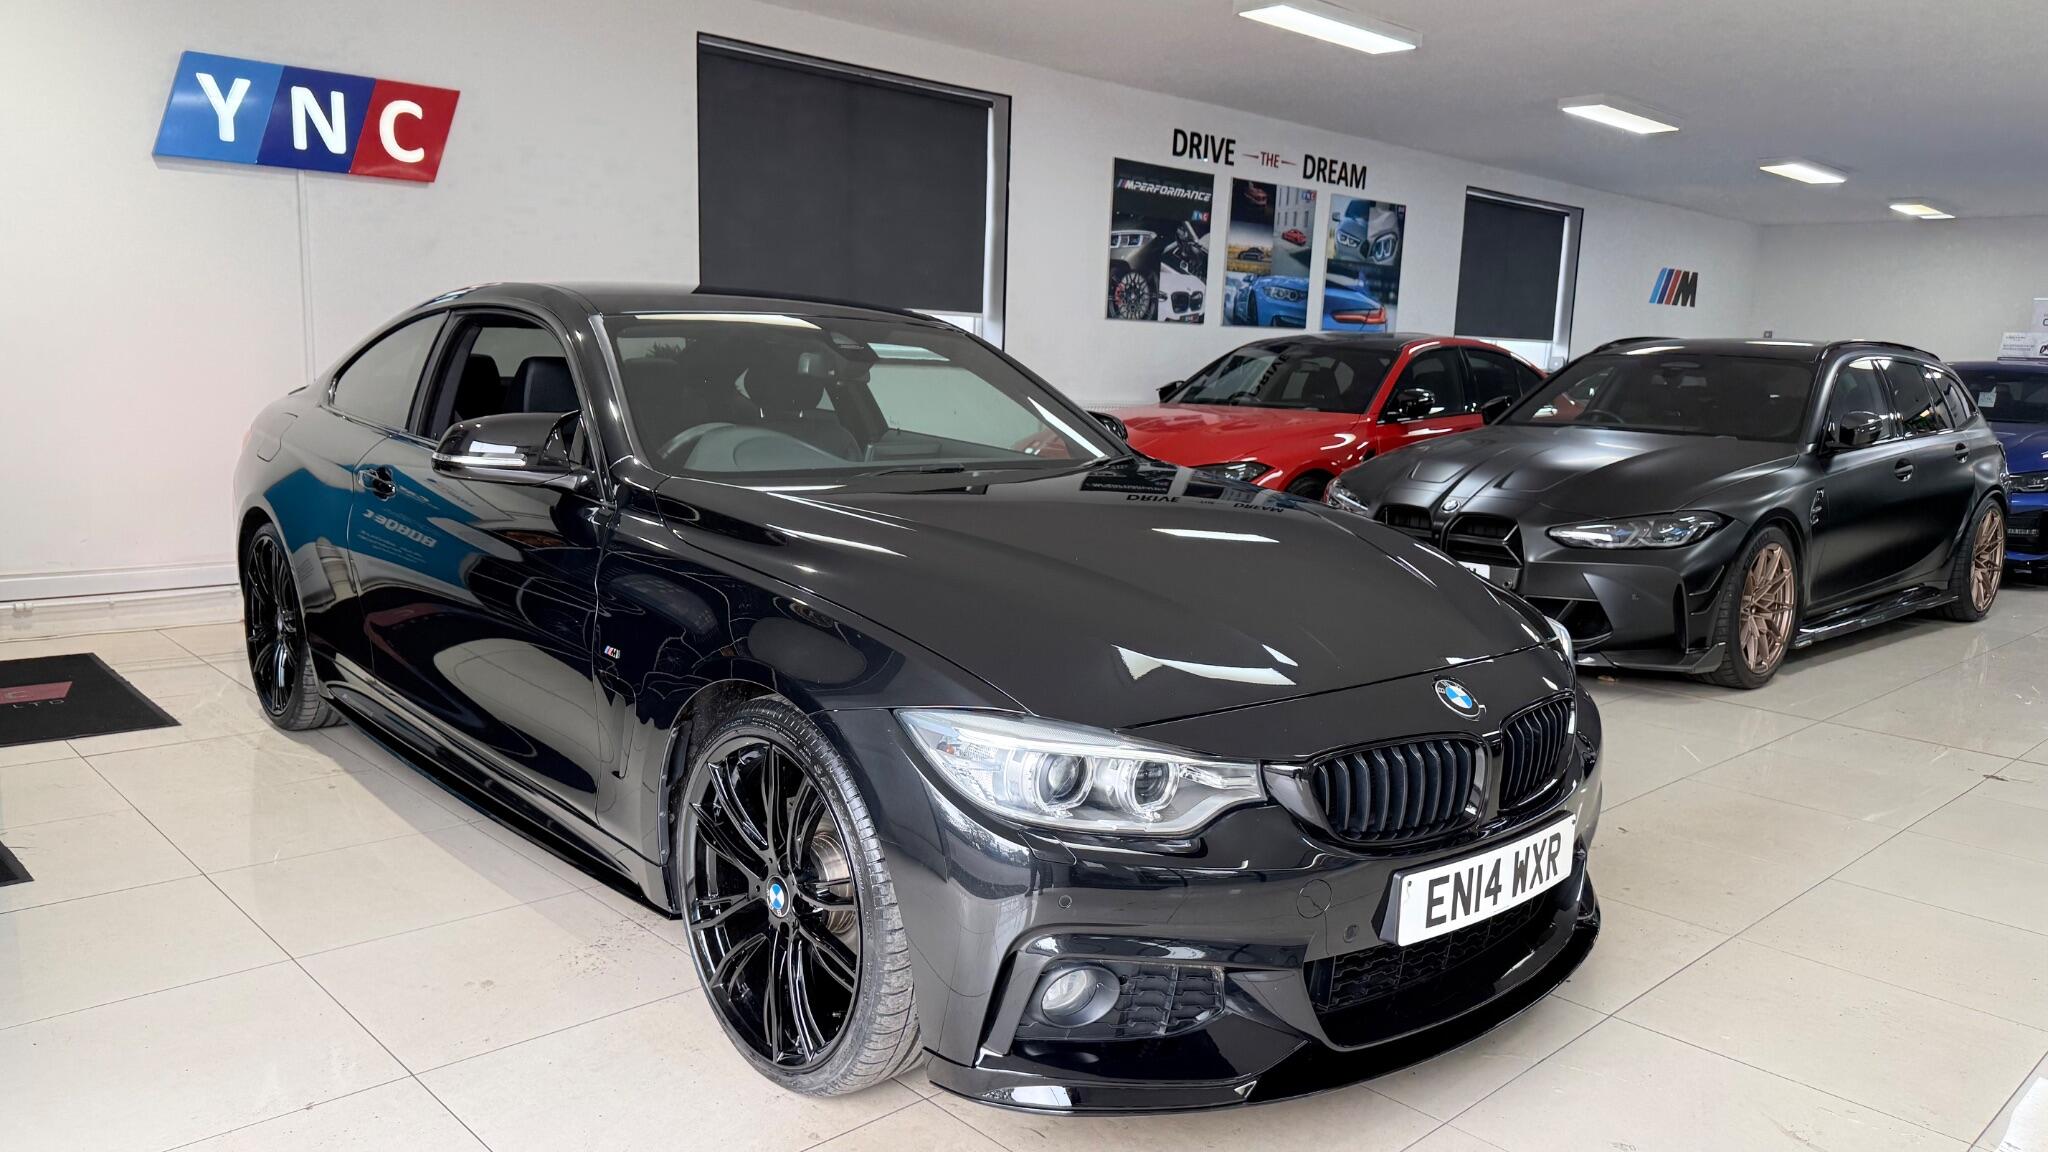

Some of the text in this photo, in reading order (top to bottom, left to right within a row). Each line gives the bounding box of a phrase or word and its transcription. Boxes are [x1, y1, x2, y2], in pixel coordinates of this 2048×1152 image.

[196, 72, 425, 163] YNC
[1172, 128, 1367, 190] DRIVE THE DREAM
[1425, 832, 1562, 929] EN14 WXR
